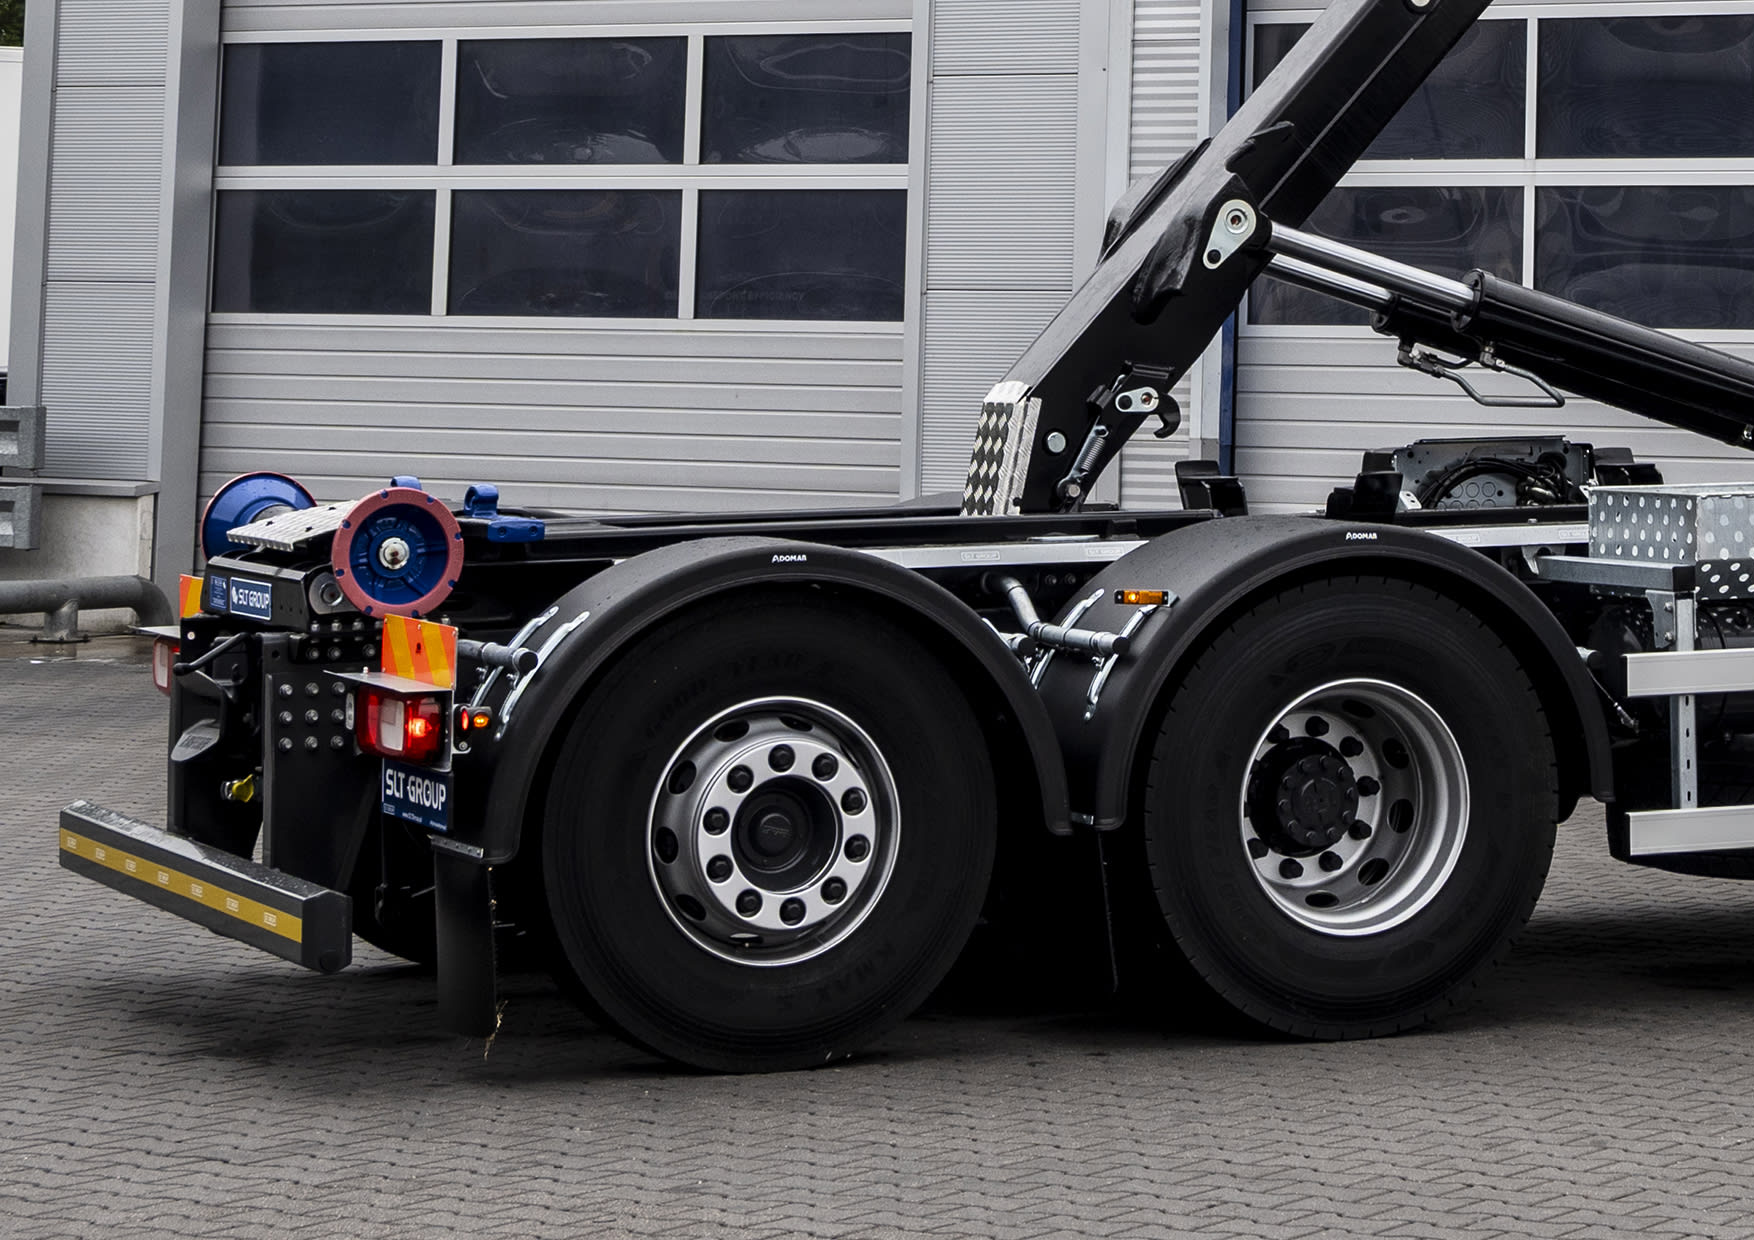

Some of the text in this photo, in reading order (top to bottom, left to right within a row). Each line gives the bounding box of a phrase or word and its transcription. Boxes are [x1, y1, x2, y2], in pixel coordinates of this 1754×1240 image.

[771, 553, 808, 563] ADOMAR
[238, 588, 249, 605] SLT
[249, 591, 270, 609] GROUP
[386, 768, 406, 799] SLT
[407, 775, 447, 811] GROUP
